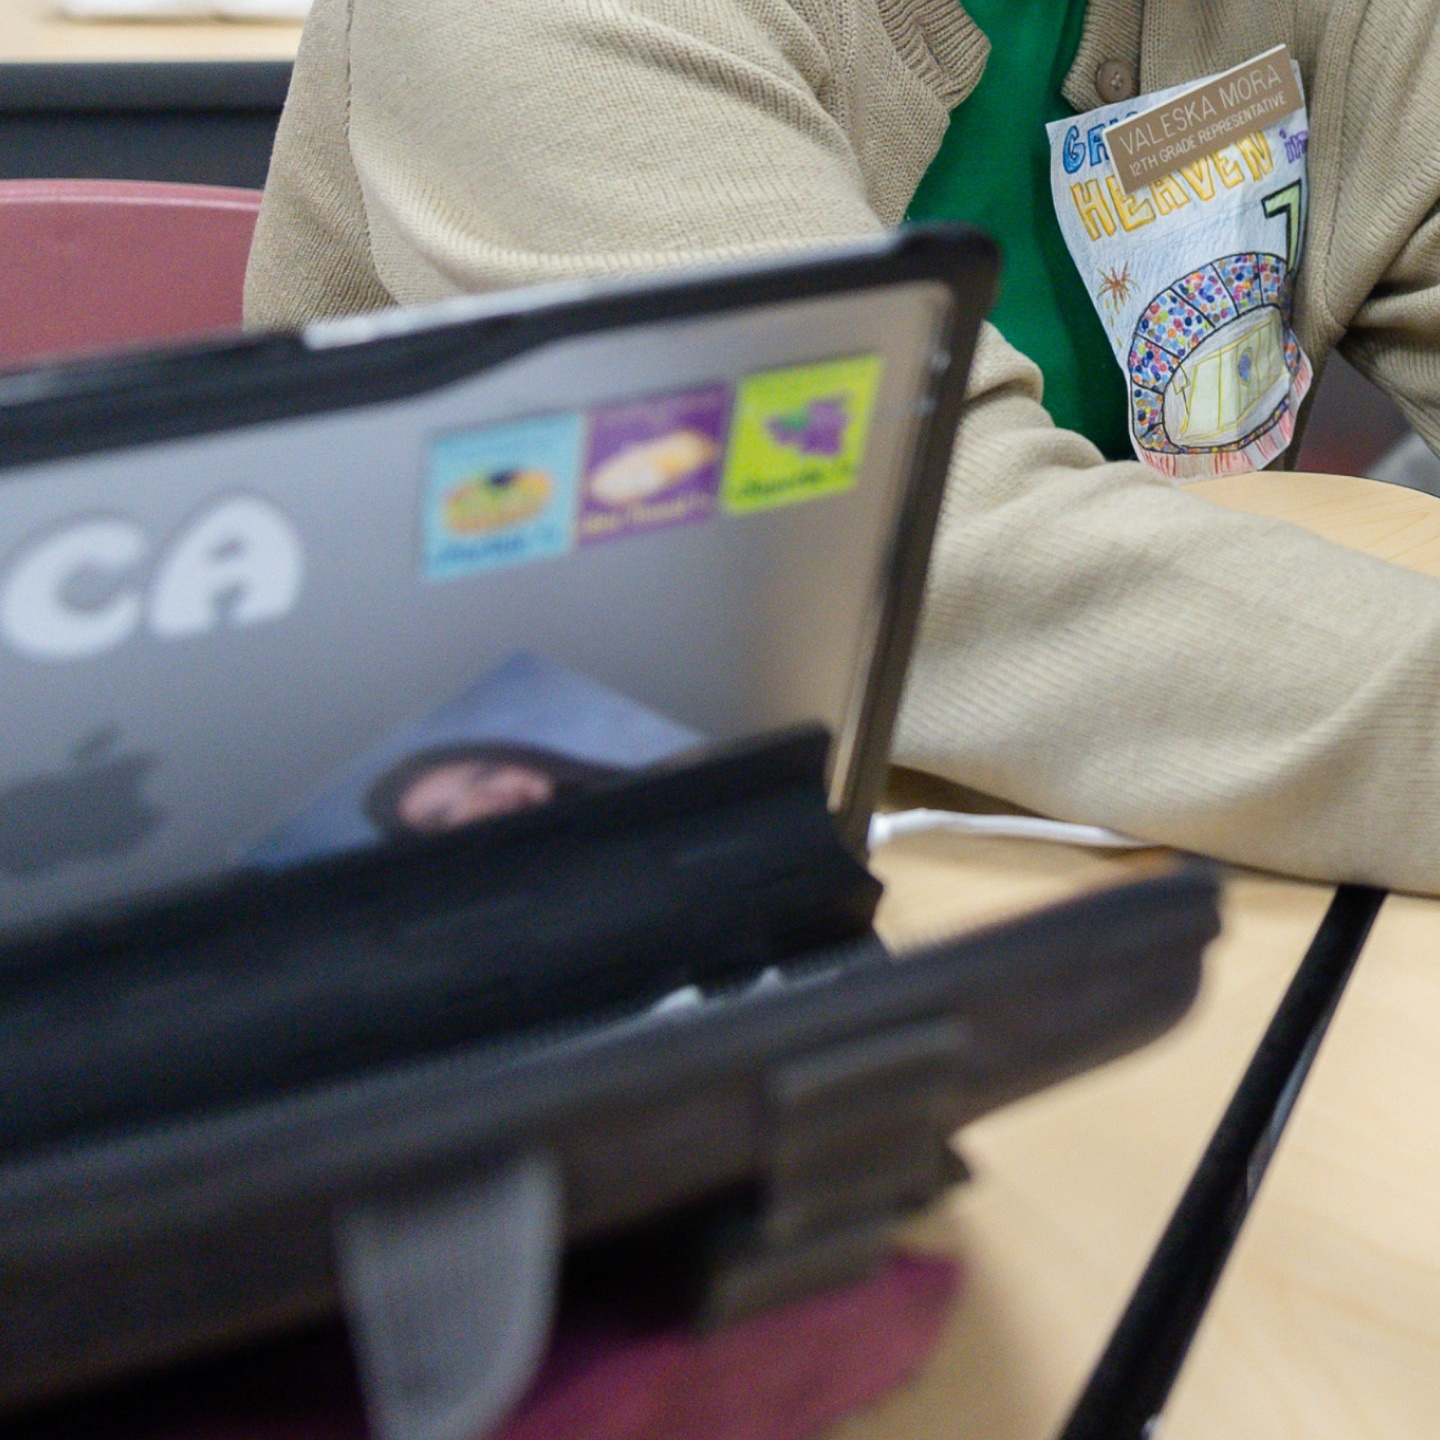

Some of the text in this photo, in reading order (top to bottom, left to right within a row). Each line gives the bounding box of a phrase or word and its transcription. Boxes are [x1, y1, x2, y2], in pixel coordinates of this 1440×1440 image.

[1119, 64, 1282, 155] VALESKA MORA
[1129, 91, 1287, 176] 12TH GRADE REPRESENTATIVE
[1070, 128, 1274, 241] HEAVEN
